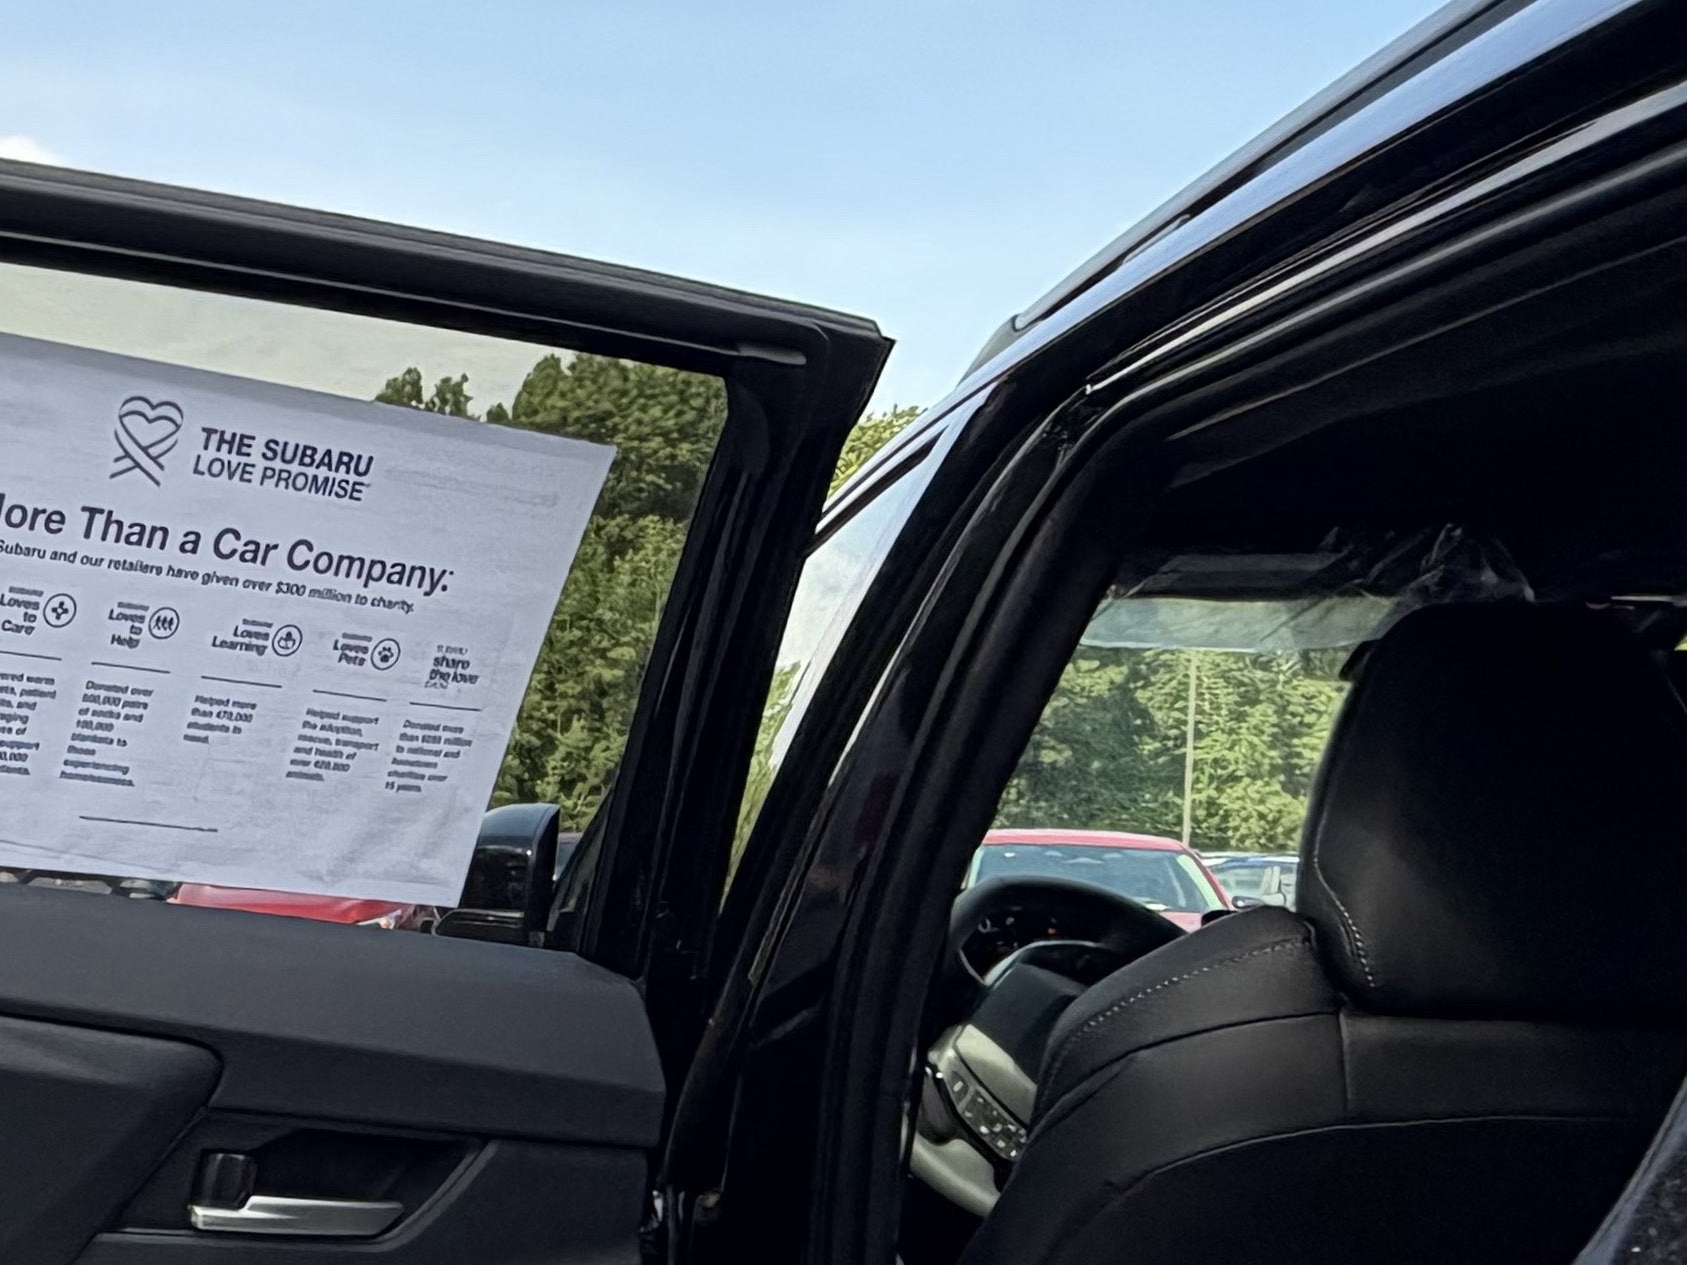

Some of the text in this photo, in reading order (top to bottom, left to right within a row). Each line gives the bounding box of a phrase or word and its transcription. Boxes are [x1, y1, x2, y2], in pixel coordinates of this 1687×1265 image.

[200, 426, 374, 476] THE SUBARU
[192, 454, 367, 502] LOVE PROMISE
[80, 505, 170, 551] Than
[179, 529, 202, 555] a
[213, 527, 279, 566] Car
[49, 551, 78, 564] and
[80, 554, 105, 567] our
[107, 559, 163, 576] retailers
[166, 565, 199, 580] have
[201, 571, 239, 587] given
[242, 578, 272, 592] over
[275, 580, 306, 597] $300
[308, 587, 352, 604] million
[354, 593, 368, 606] to
[0, 593, 41, 610] Loves
[23, 611, 37, 623] to
[108, 608, 146, 624] Loves
[1, 619, 35, 636] Care
[211, 635, 269, 656] Learning
[338, 653, 366, 667] Pets
[433, 655, 470, 670] share
